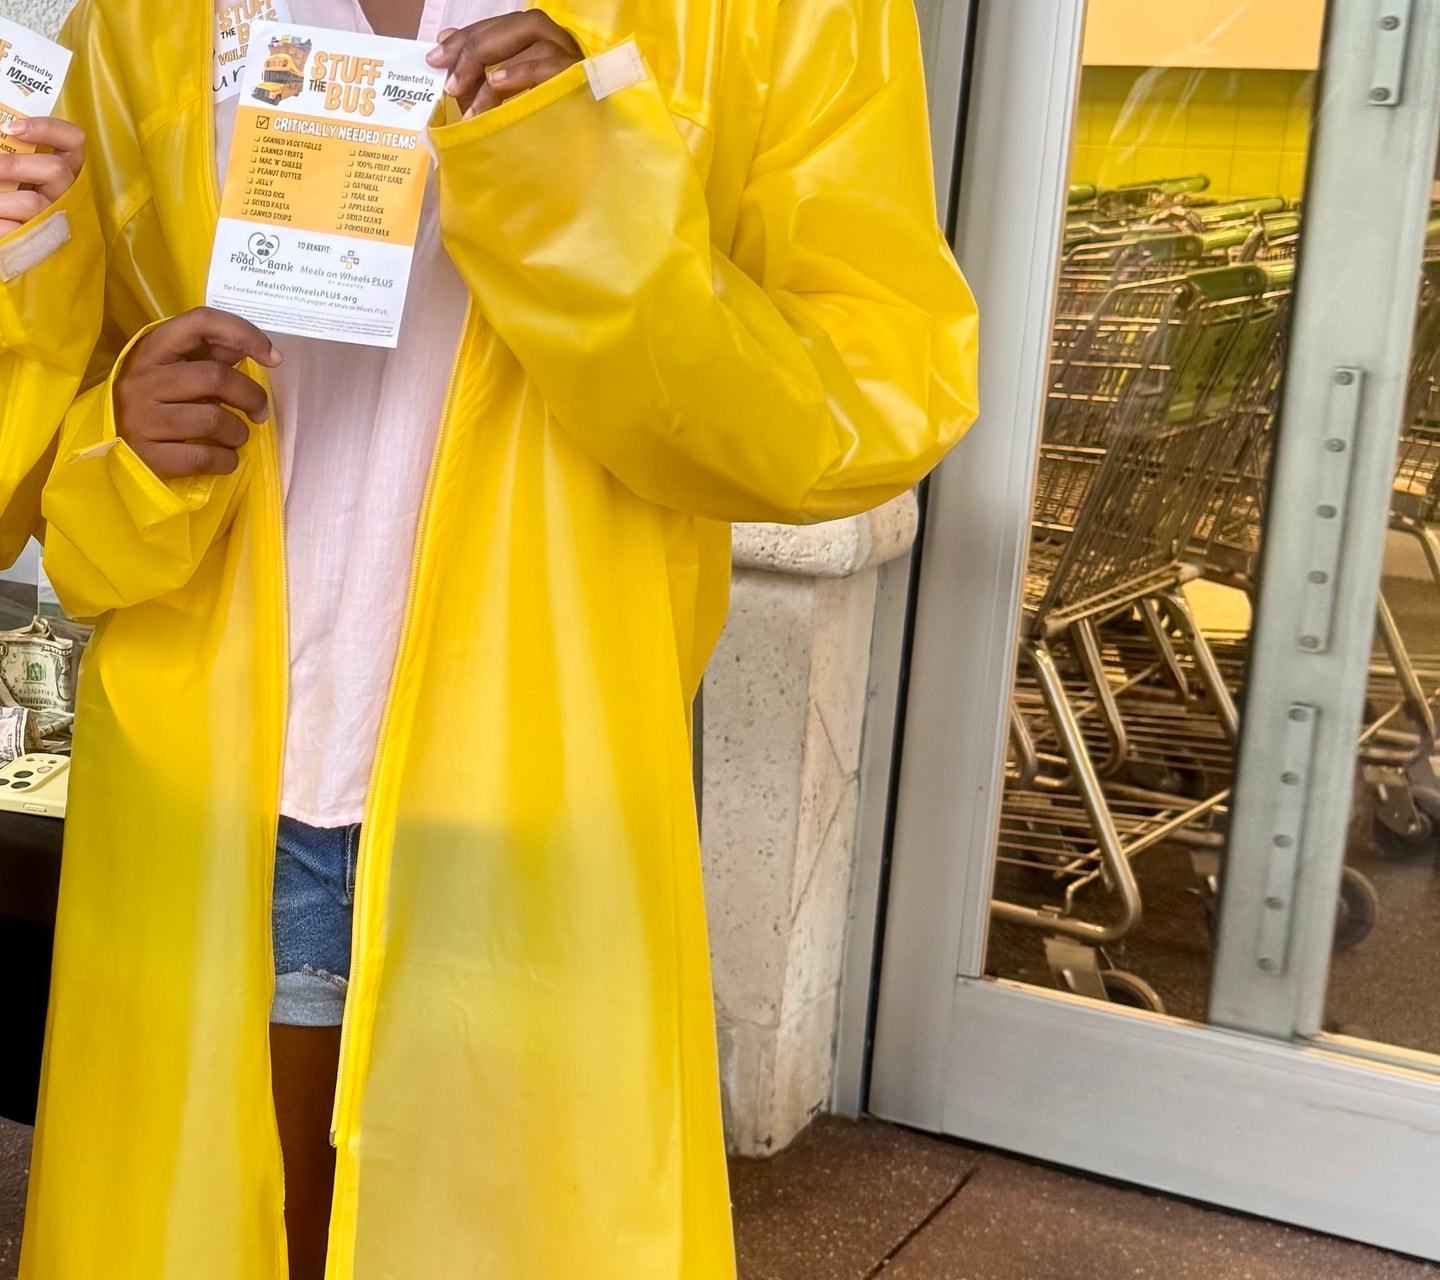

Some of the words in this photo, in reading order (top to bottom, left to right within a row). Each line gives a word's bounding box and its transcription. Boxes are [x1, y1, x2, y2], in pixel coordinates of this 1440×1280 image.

[221, 27, 236, 39] THE
[13, 55, 45, 75] Presented
[309, 50, 384, 87] STUFF
[6, 66, 53, 95] Mosaic
[307, 79, 328, 92] THE
[387, 71, 424, 84] Presented
[424, 76, 434, 86] by
[323, 82, 378, 117] BUS
[382, 83, 435, 103] Mosaic
[272, 116, 337, 138] CRITICALLY
[337, 126, 380, 144] NEEDED
[381, 132, 416, 150] ITEMS
[297, 241, 305, 249] TO
[230, 253, 254, 265] Food
[267, 258, 294, 272] Bank
[299, 265, 324, 276] Meals
[339, 271, 370, 283] Wheels
[371, 277, 393, 288] PLUS
[255, 279, 358, 304] MealsOnWheelsPLUS.org
